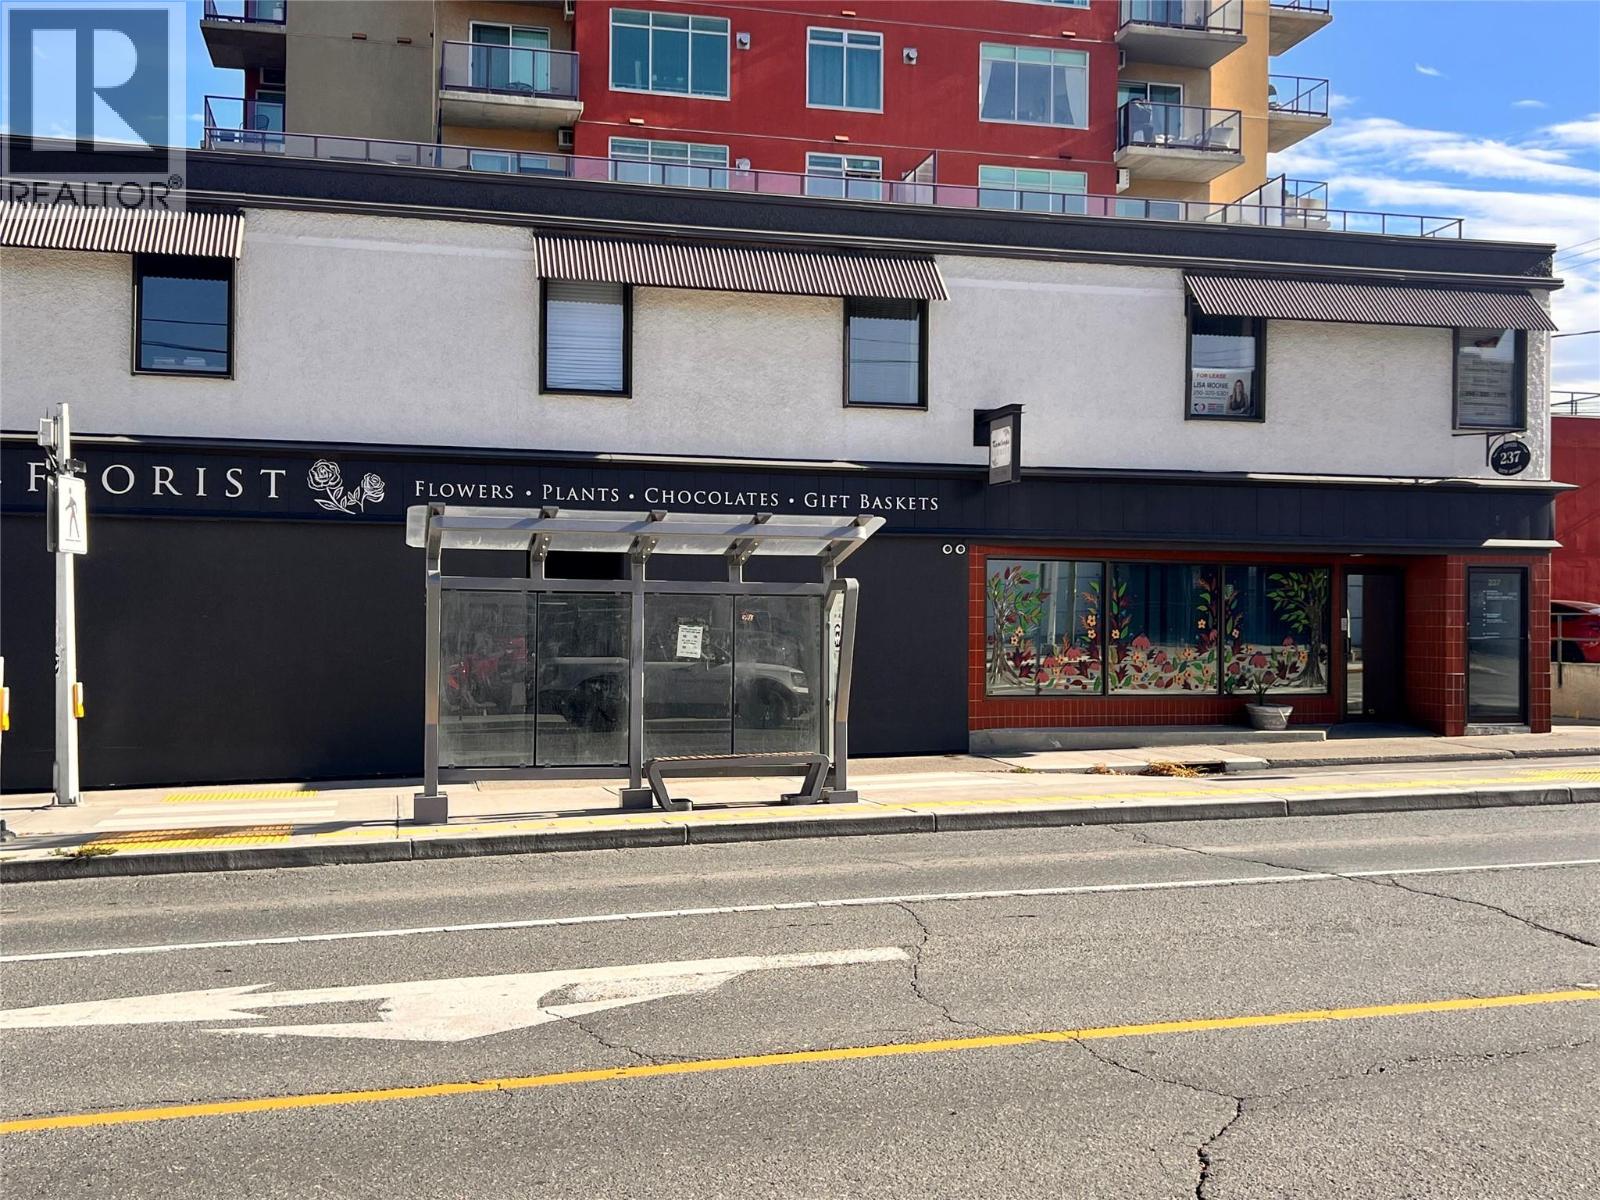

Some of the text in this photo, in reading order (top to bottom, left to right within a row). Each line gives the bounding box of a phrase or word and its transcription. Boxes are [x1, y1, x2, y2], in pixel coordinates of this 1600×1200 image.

[1193, 381, 1206, 389] LISA
[1500, 450, 1521, 465] 237
[27, 462, 286, 498] FORIST
[415, 480, 938, 511] FLOWERS PLANTS CHOCOLATES GIFT BASKETS
